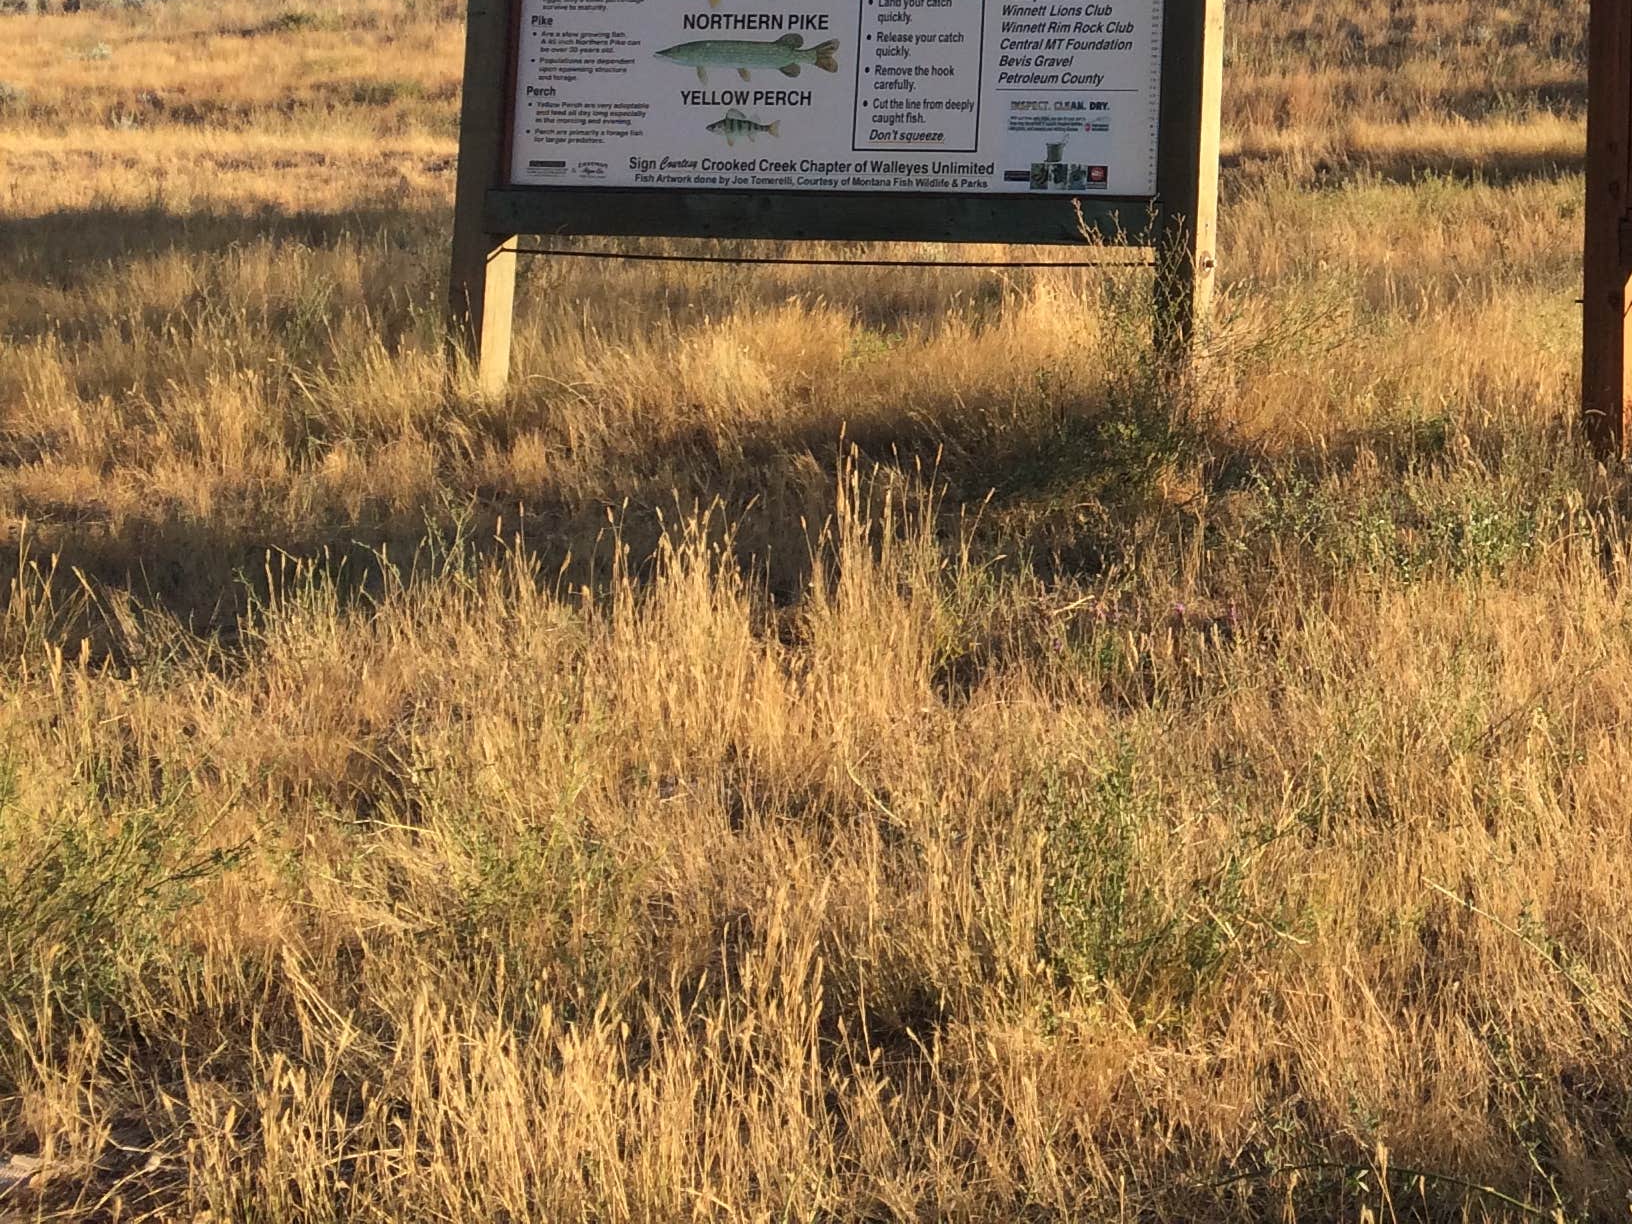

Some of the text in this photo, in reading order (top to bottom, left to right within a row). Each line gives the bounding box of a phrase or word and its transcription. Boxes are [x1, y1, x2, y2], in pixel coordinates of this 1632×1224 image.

[903, 0, 924, 10] your
[1002, 5, 1112, 16] Winnett Lions Club
[531, 16, 553, 25] Pike
[683, 14, 829, 29] NORTHERN PIKE
[877, 11, 912, 25] quickly.
[1001, 22, 1134, 33] Winnett Rim Rock Club
[876, 32, 964, 45] Release your catch
[1000, 39, 1132, 50] Central MT Foundation
[875, 46, 911, 59] quickly.
[999, 55, 1073, 67] Bevis Gravel
[875, 65, 954, 76] Remove the hook
[874, 79, 916, 92] carefully.
[998, 72, 1104, 87] Petroleum County
[527, 86, 556, 96] Perch
[681, 91, 811, 105] YELLOW PERCH
[873, 99, 974, 112] Cut the line from deeply
[1089, 102, 1110, 110] DRY.
[872, 113, 926, 125] caught fish.
[869, 130, 899, 141] Don't
[629, 157, 656, 172] Sign
[702, 158, 756, 171] Crooked
[759, 159, 797, 171] Creek
[800, 160, 852, 174] Chapter
[855, 160, 867, 173] of
[870, 160, 928, 176] Walleyes
[932, 162, 994, 174] Unlimited
